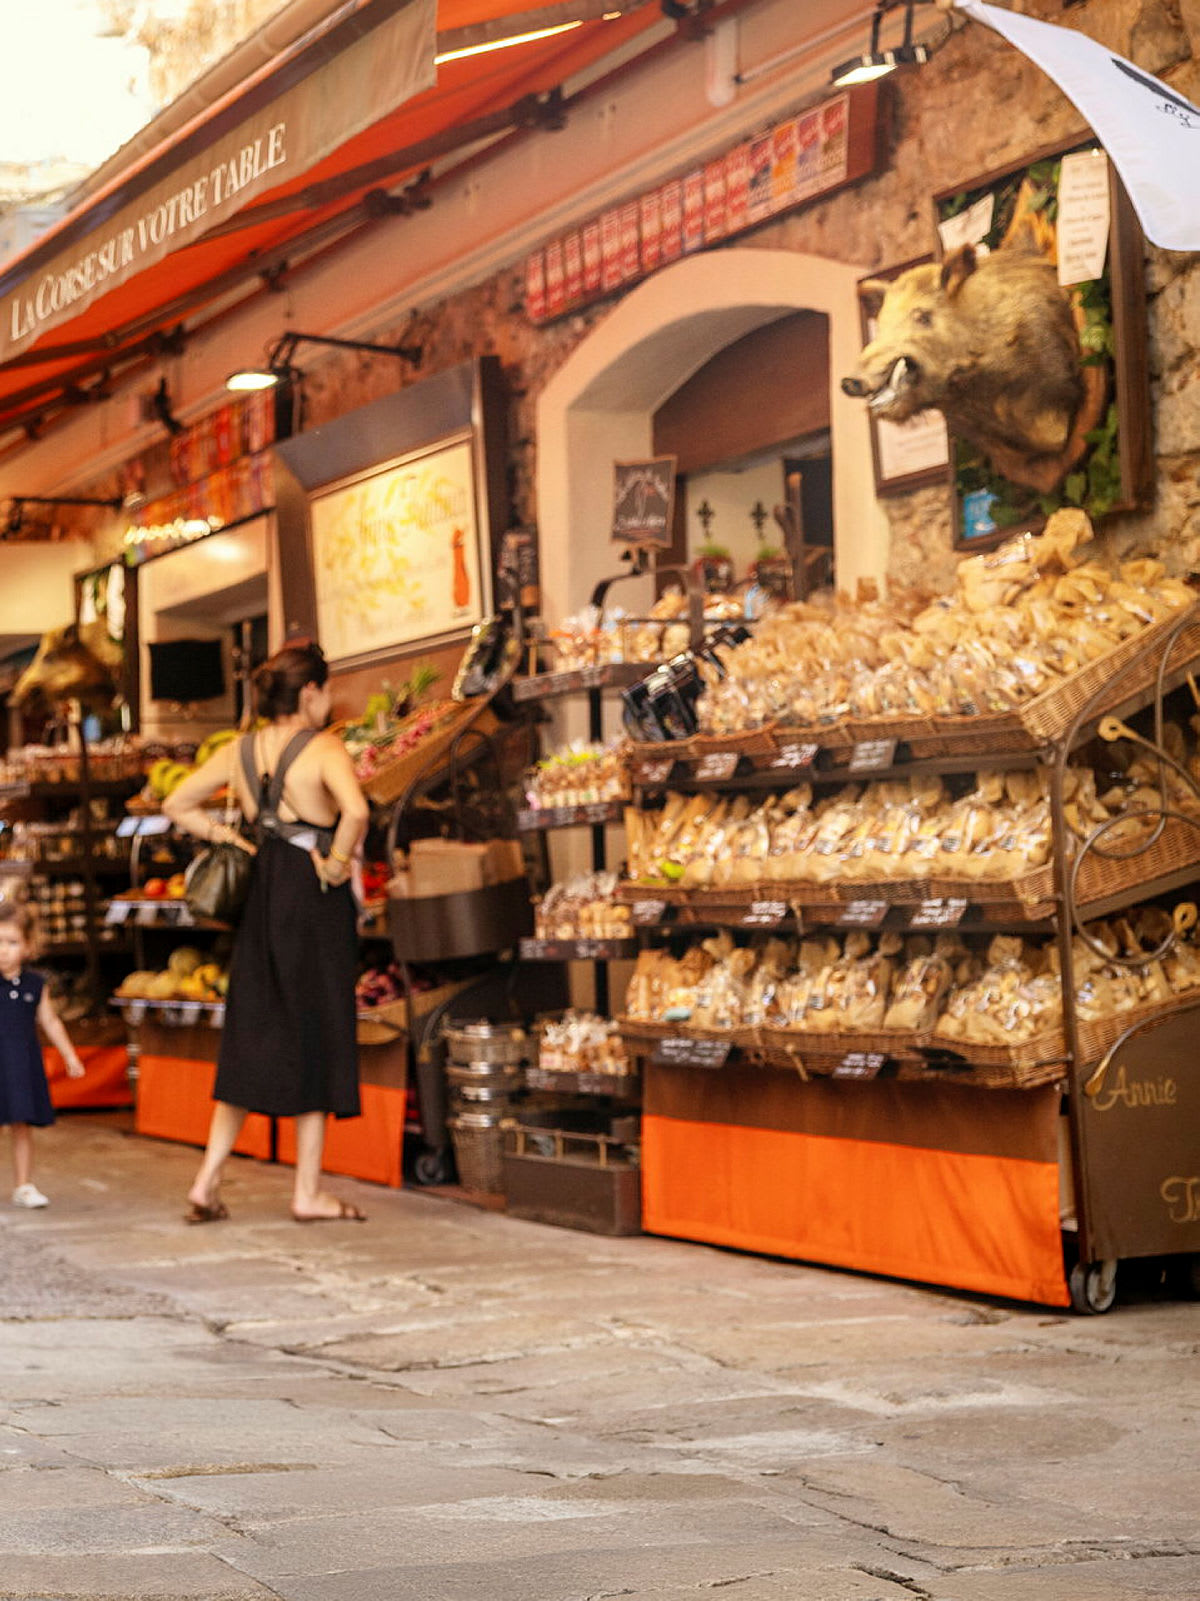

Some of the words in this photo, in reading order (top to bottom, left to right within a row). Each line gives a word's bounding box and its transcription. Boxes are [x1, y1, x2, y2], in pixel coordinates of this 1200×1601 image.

[36, 253, 97, 321] CORSE
[96, 228, 136, 281] SUR
[137, 177, 209, 252] VOTRE
[211, 123, 286, 207] TABLE
[1092, 1066, 1176, 1111] Annie
